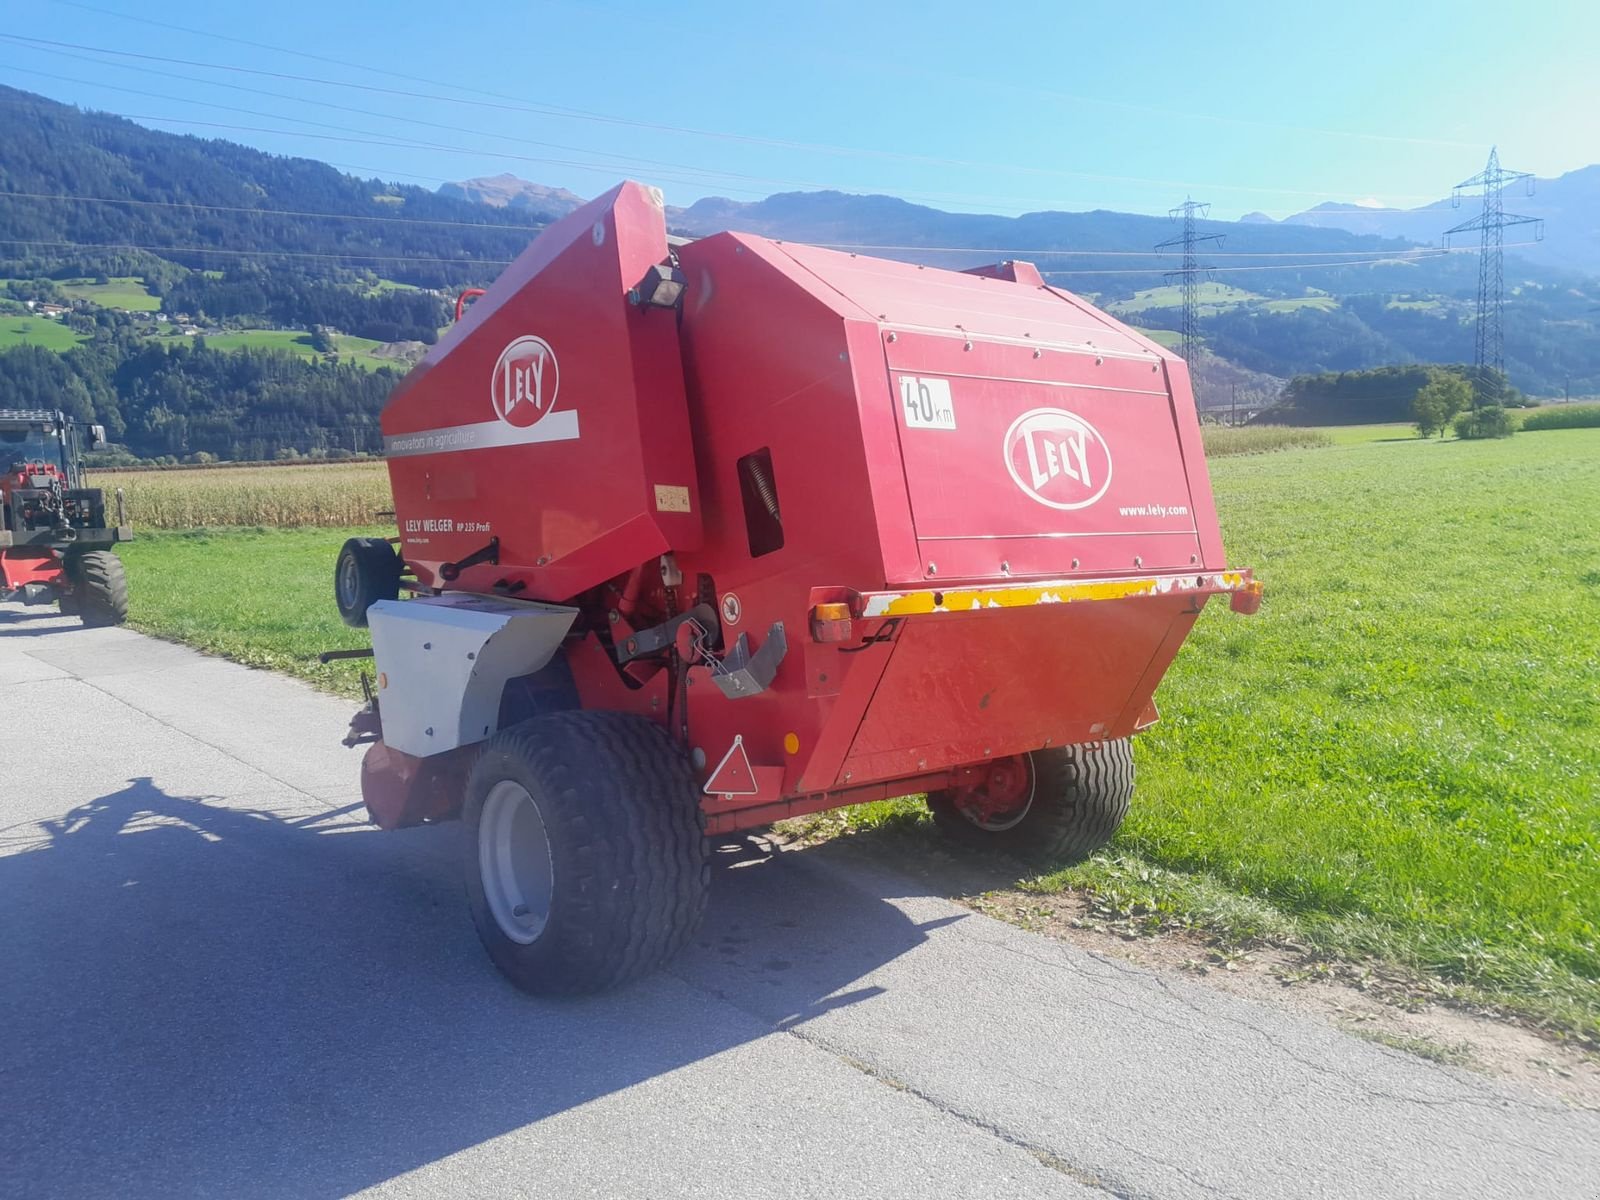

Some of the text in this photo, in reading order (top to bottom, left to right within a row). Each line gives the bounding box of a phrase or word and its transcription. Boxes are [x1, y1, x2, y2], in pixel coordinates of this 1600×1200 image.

[504, 350, 545, 416] LELY
[906, 382, 953, 423] 40 km
[425, 434, 434, 448] in
[433, 430, 476, 449] agriculture
[1022, 427, 1092, 491] LELY
[405, 519, 491, 532] LELY WELGER RP 235 Profi
[1119, 503, 1188, 518] www.lely.com
